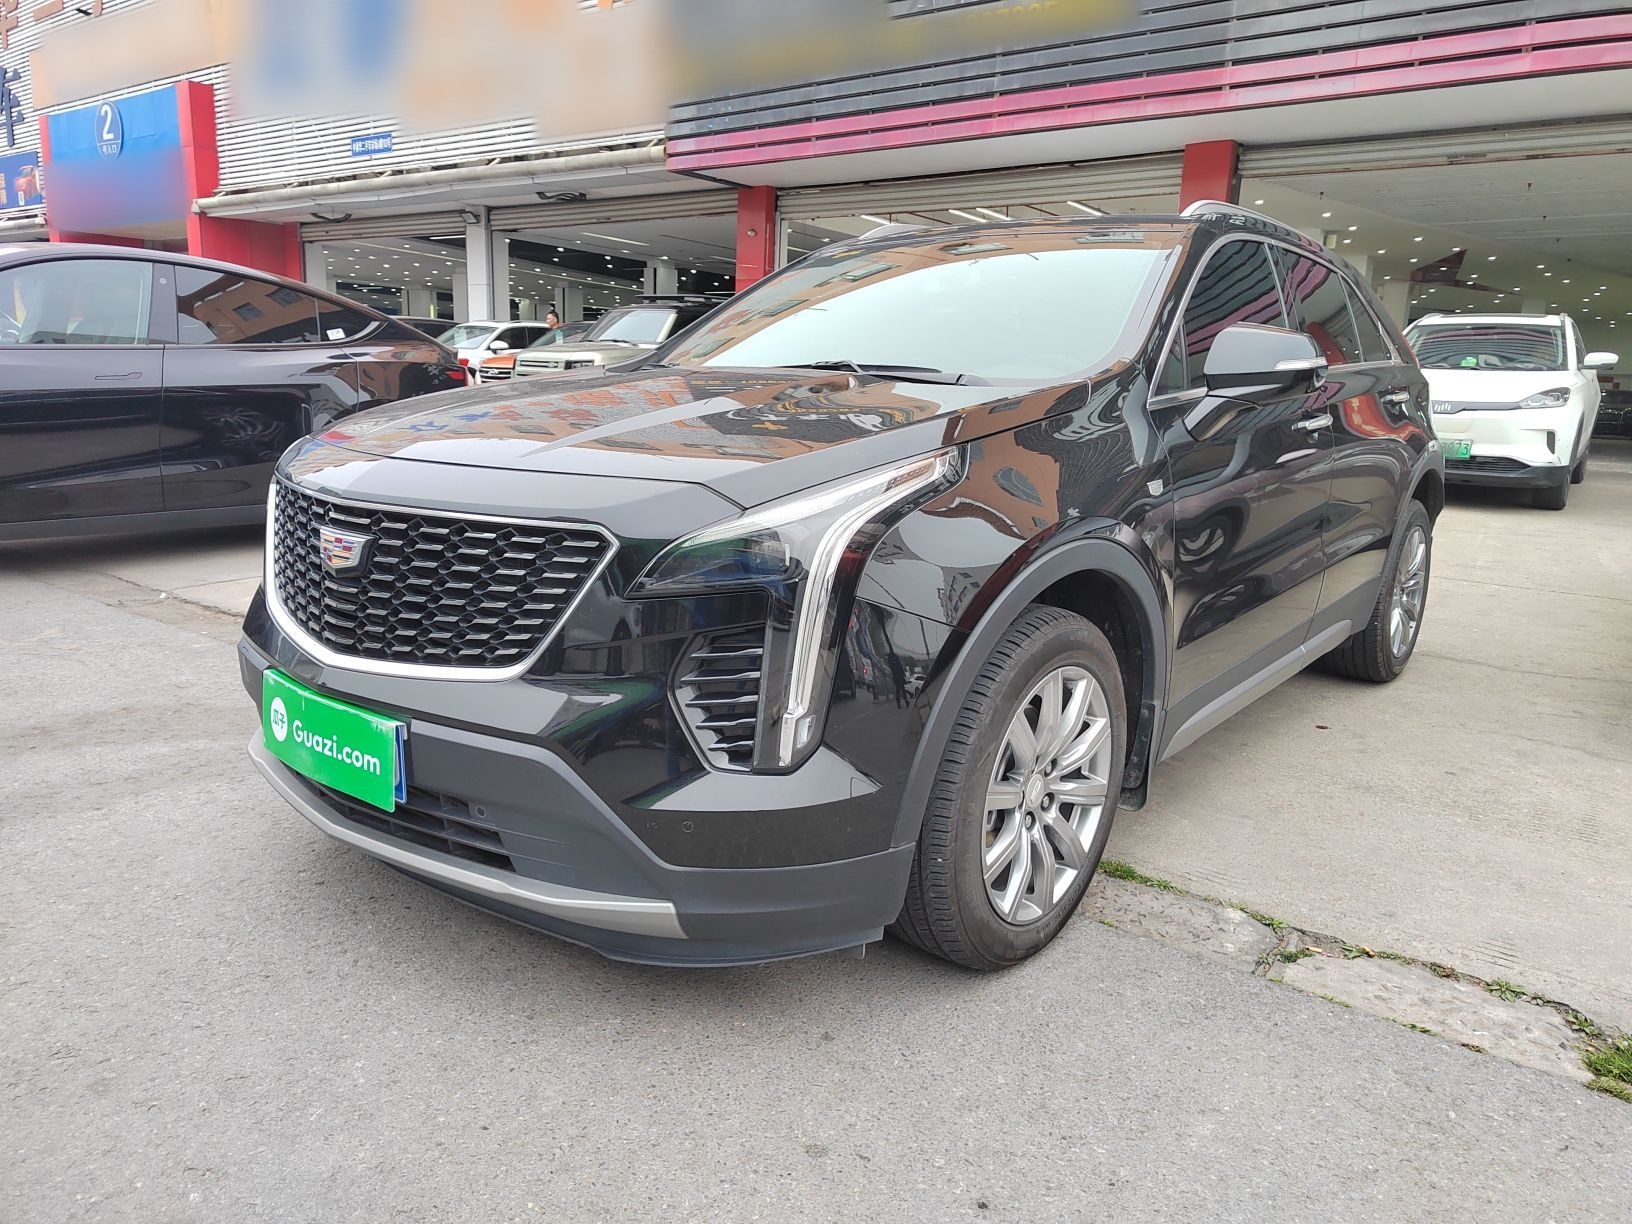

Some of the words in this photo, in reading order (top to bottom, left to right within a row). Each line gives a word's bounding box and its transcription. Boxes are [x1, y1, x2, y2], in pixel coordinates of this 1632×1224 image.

[100, 104, 114, 140] 2
[272, 708, 286, 730] 瓜子
[292, 719, 381, 776] Guazi.com
